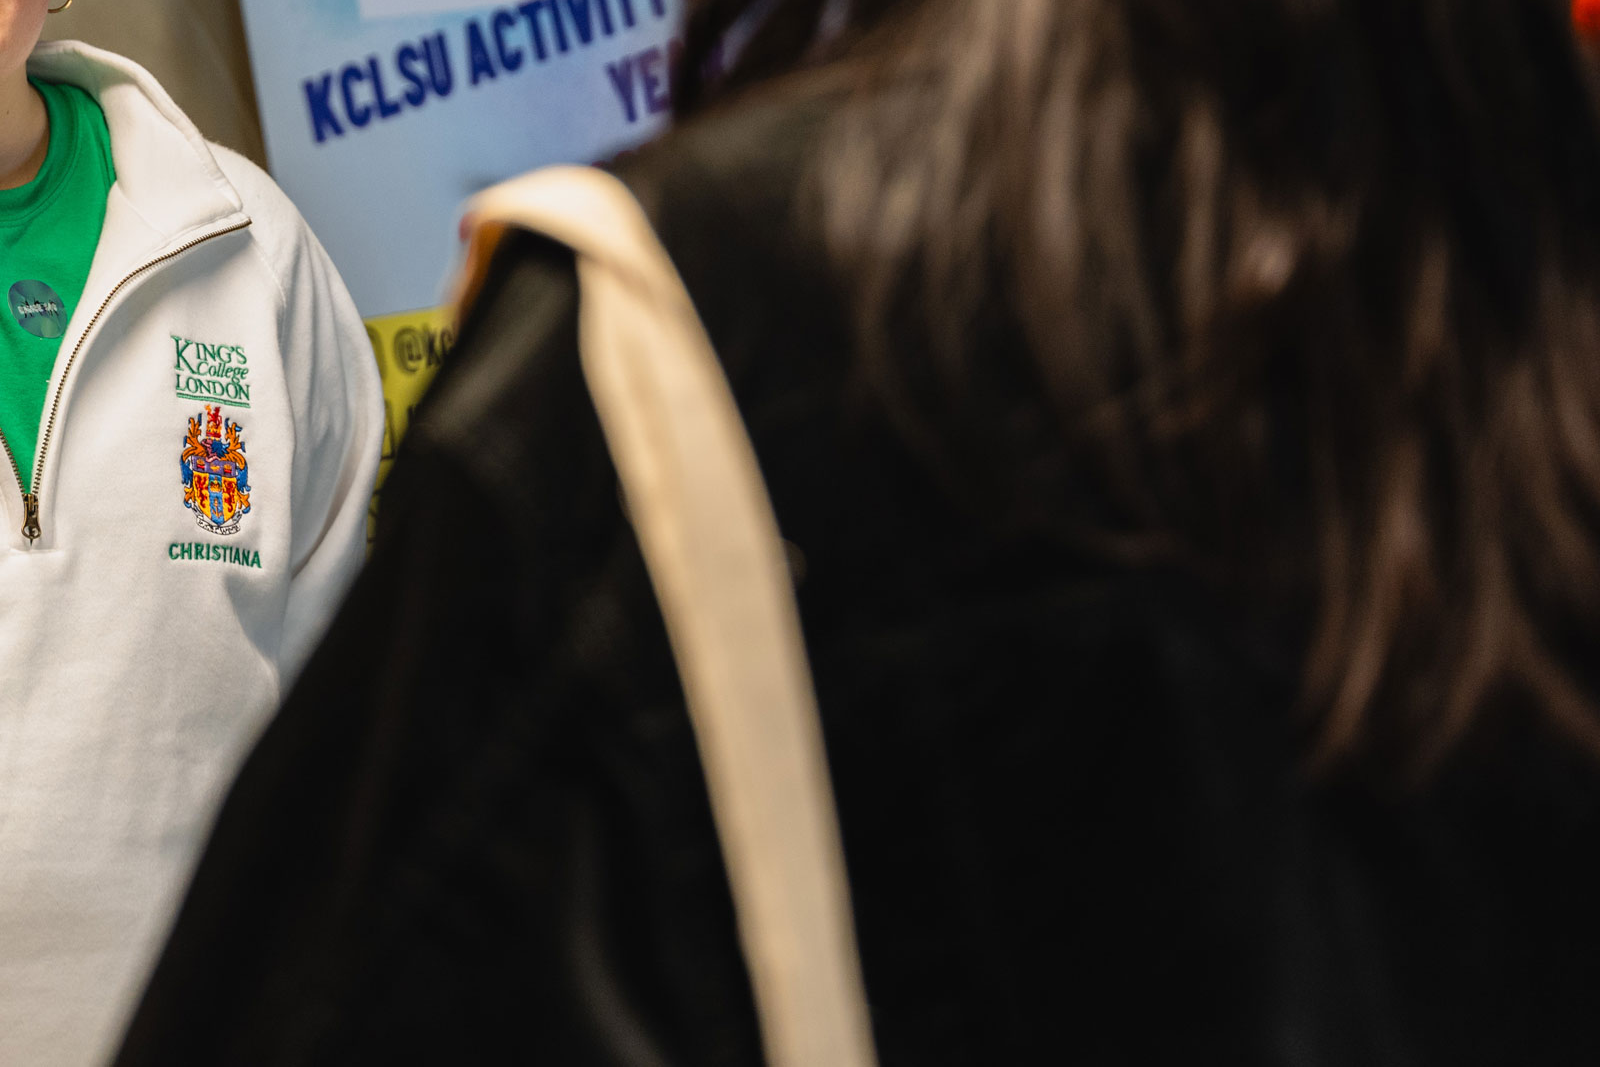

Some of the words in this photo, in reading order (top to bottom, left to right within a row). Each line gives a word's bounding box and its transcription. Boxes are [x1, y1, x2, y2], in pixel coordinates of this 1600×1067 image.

[303, 30, 457, 144] KCLSU
[171, 335, 248, 374] KING'S
[196, 361, 249, 384] College
[176, 375, 250, 401] LONDON
[168, 542, 262, 569] CHRISTIANA
